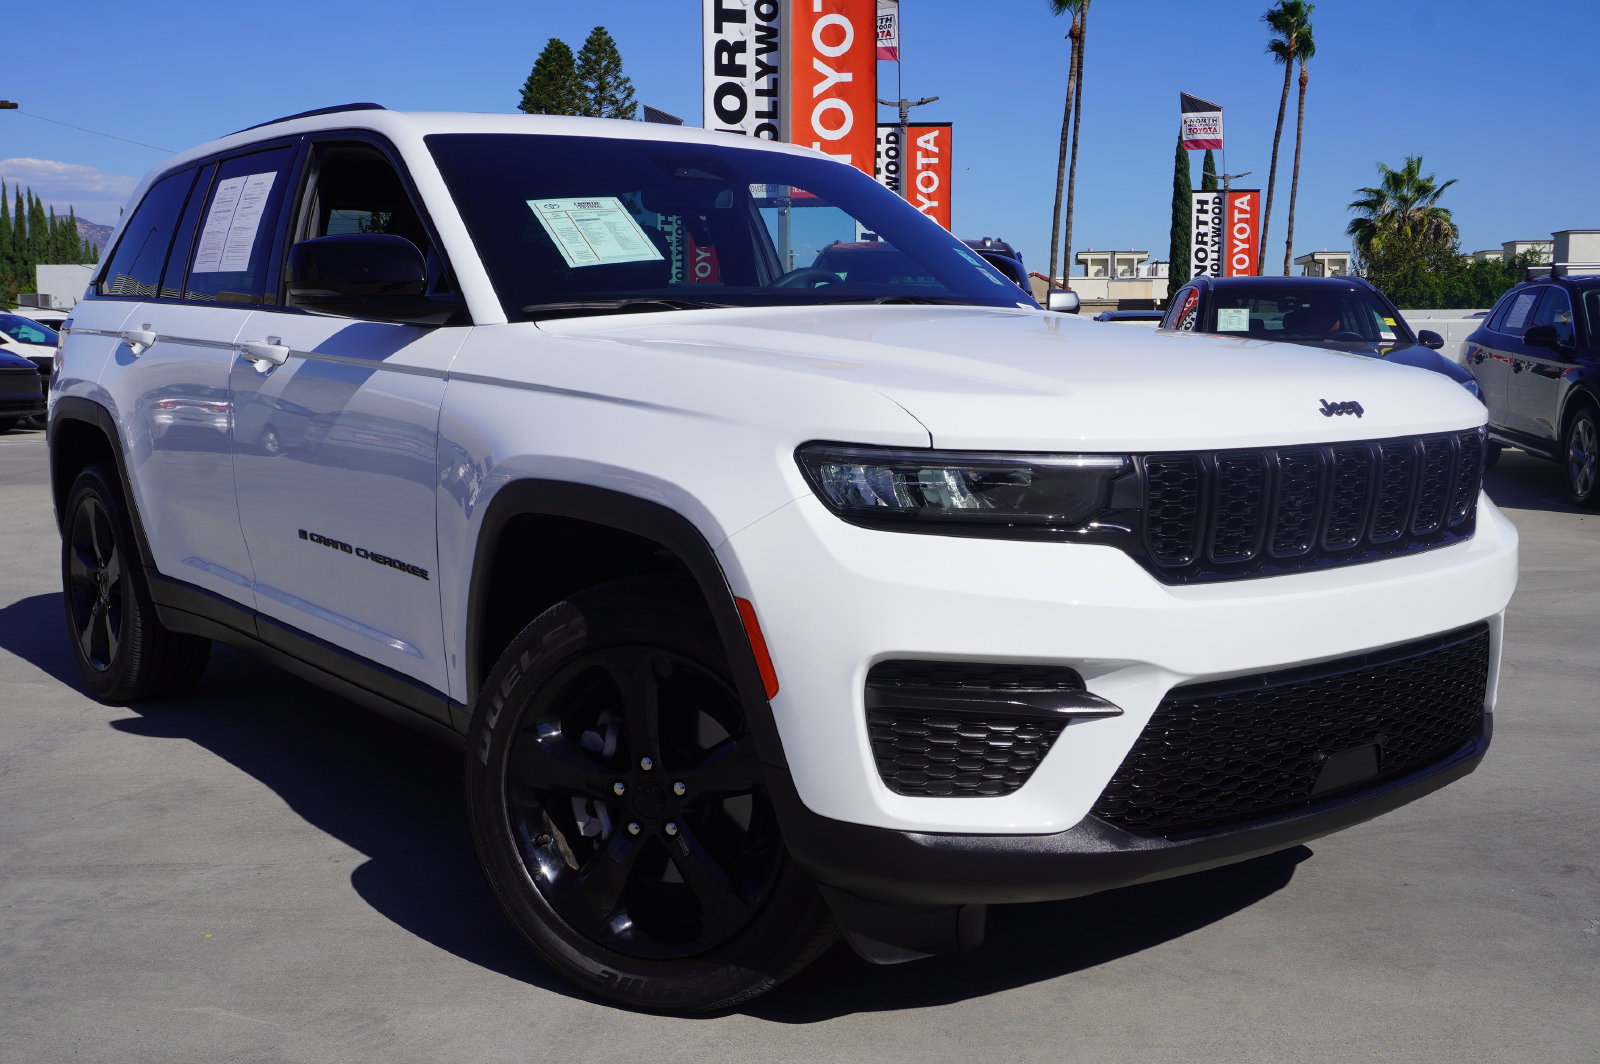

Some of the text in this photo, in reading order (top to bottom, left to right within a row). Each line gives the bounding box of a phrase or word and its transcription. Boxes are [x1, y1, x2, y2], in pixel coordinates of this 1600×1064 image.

[714, 0, 747, 134] ORT
[1187, 126, 1218, 134] TOYOTA
[1194, 198, 1210, 277] NORTH
[1232, 194, 1250, 276] TOYOTA
[1319, 398, 1365, 419] Jeep
[308, 532, 430, 581] GRAND CHEROKEE
